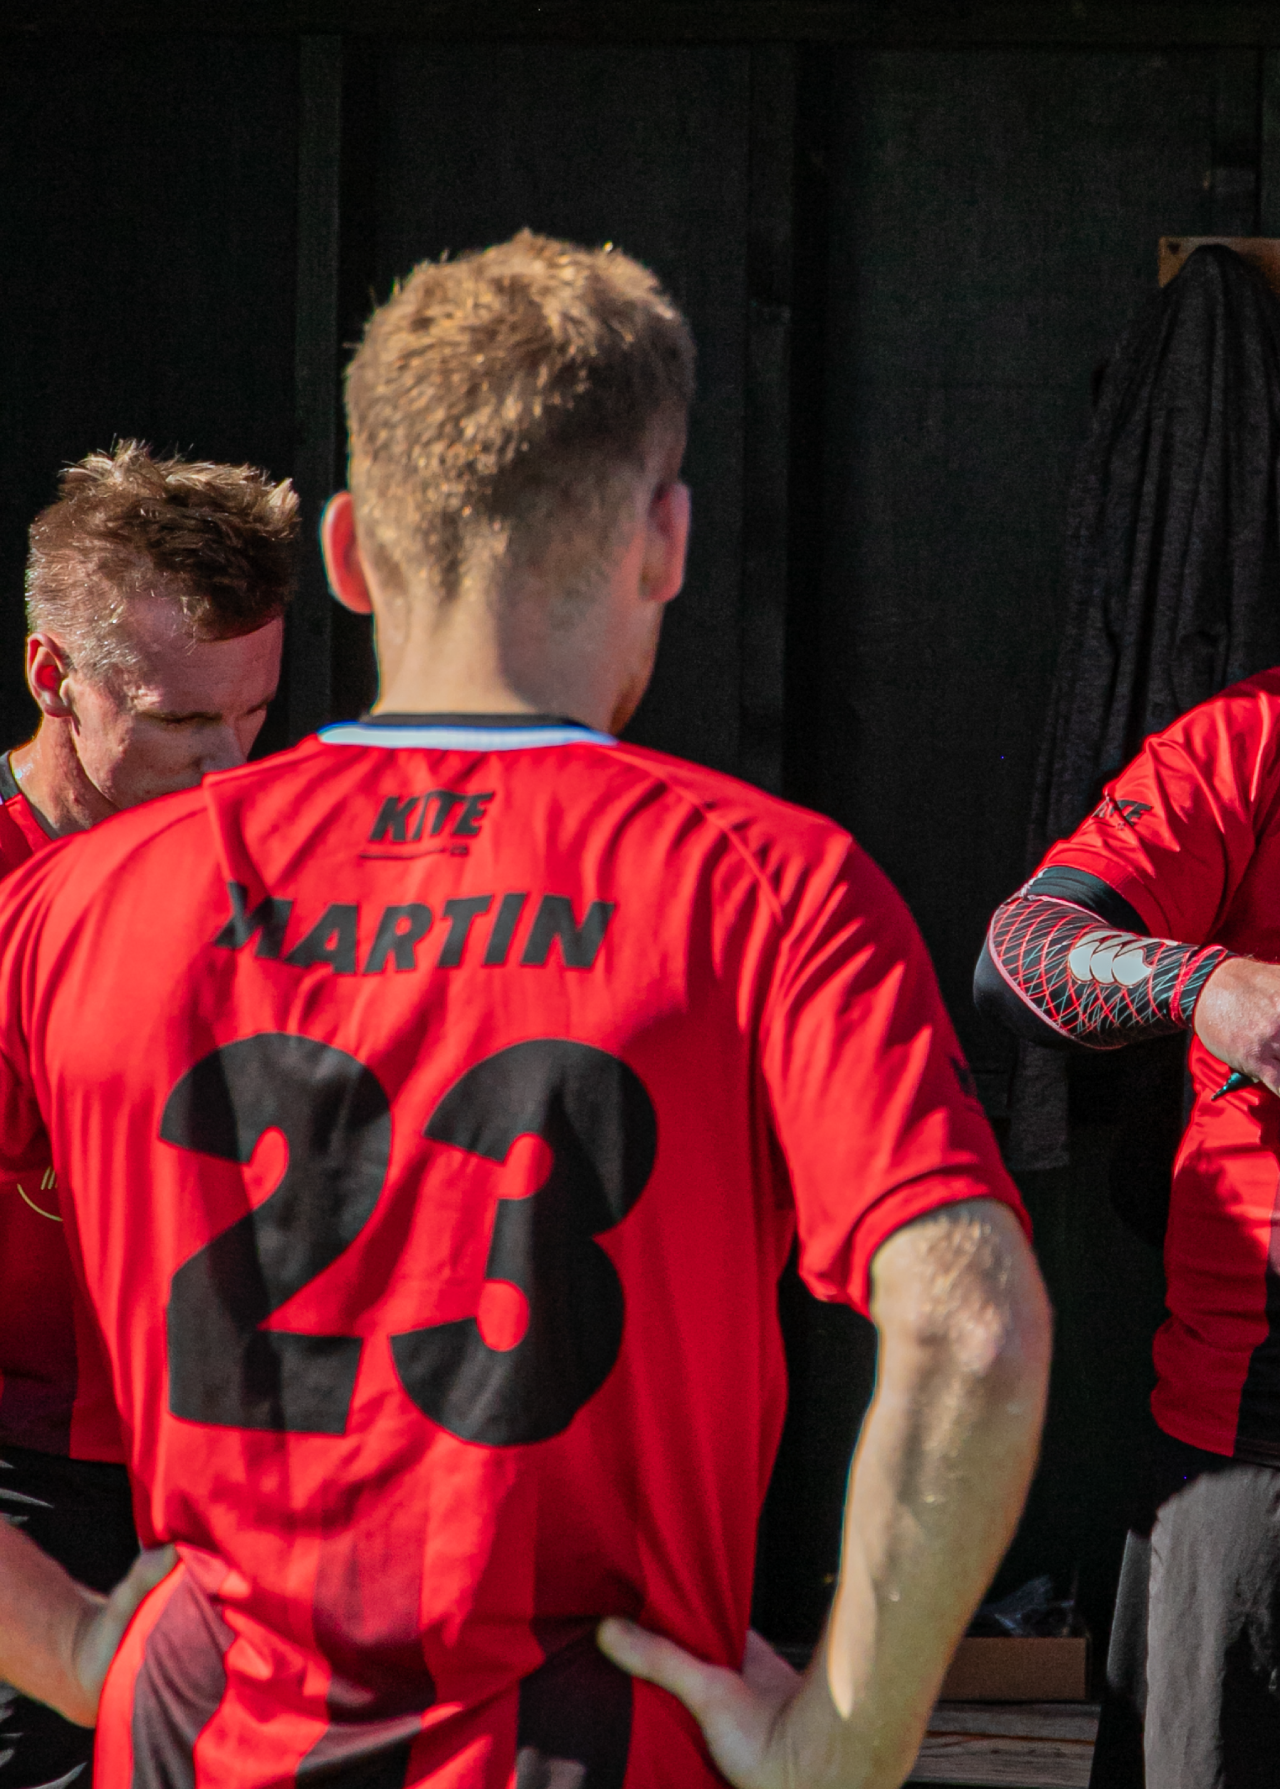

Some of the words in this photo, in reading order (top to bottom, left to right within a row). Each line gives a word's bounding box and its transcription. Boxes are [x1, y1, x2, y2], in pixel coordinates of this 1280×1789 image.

[368, 789, 495, 843] KITE
[214, 881, 616, 975] MARTIN
[158, 1030, 658, 1447] 23
